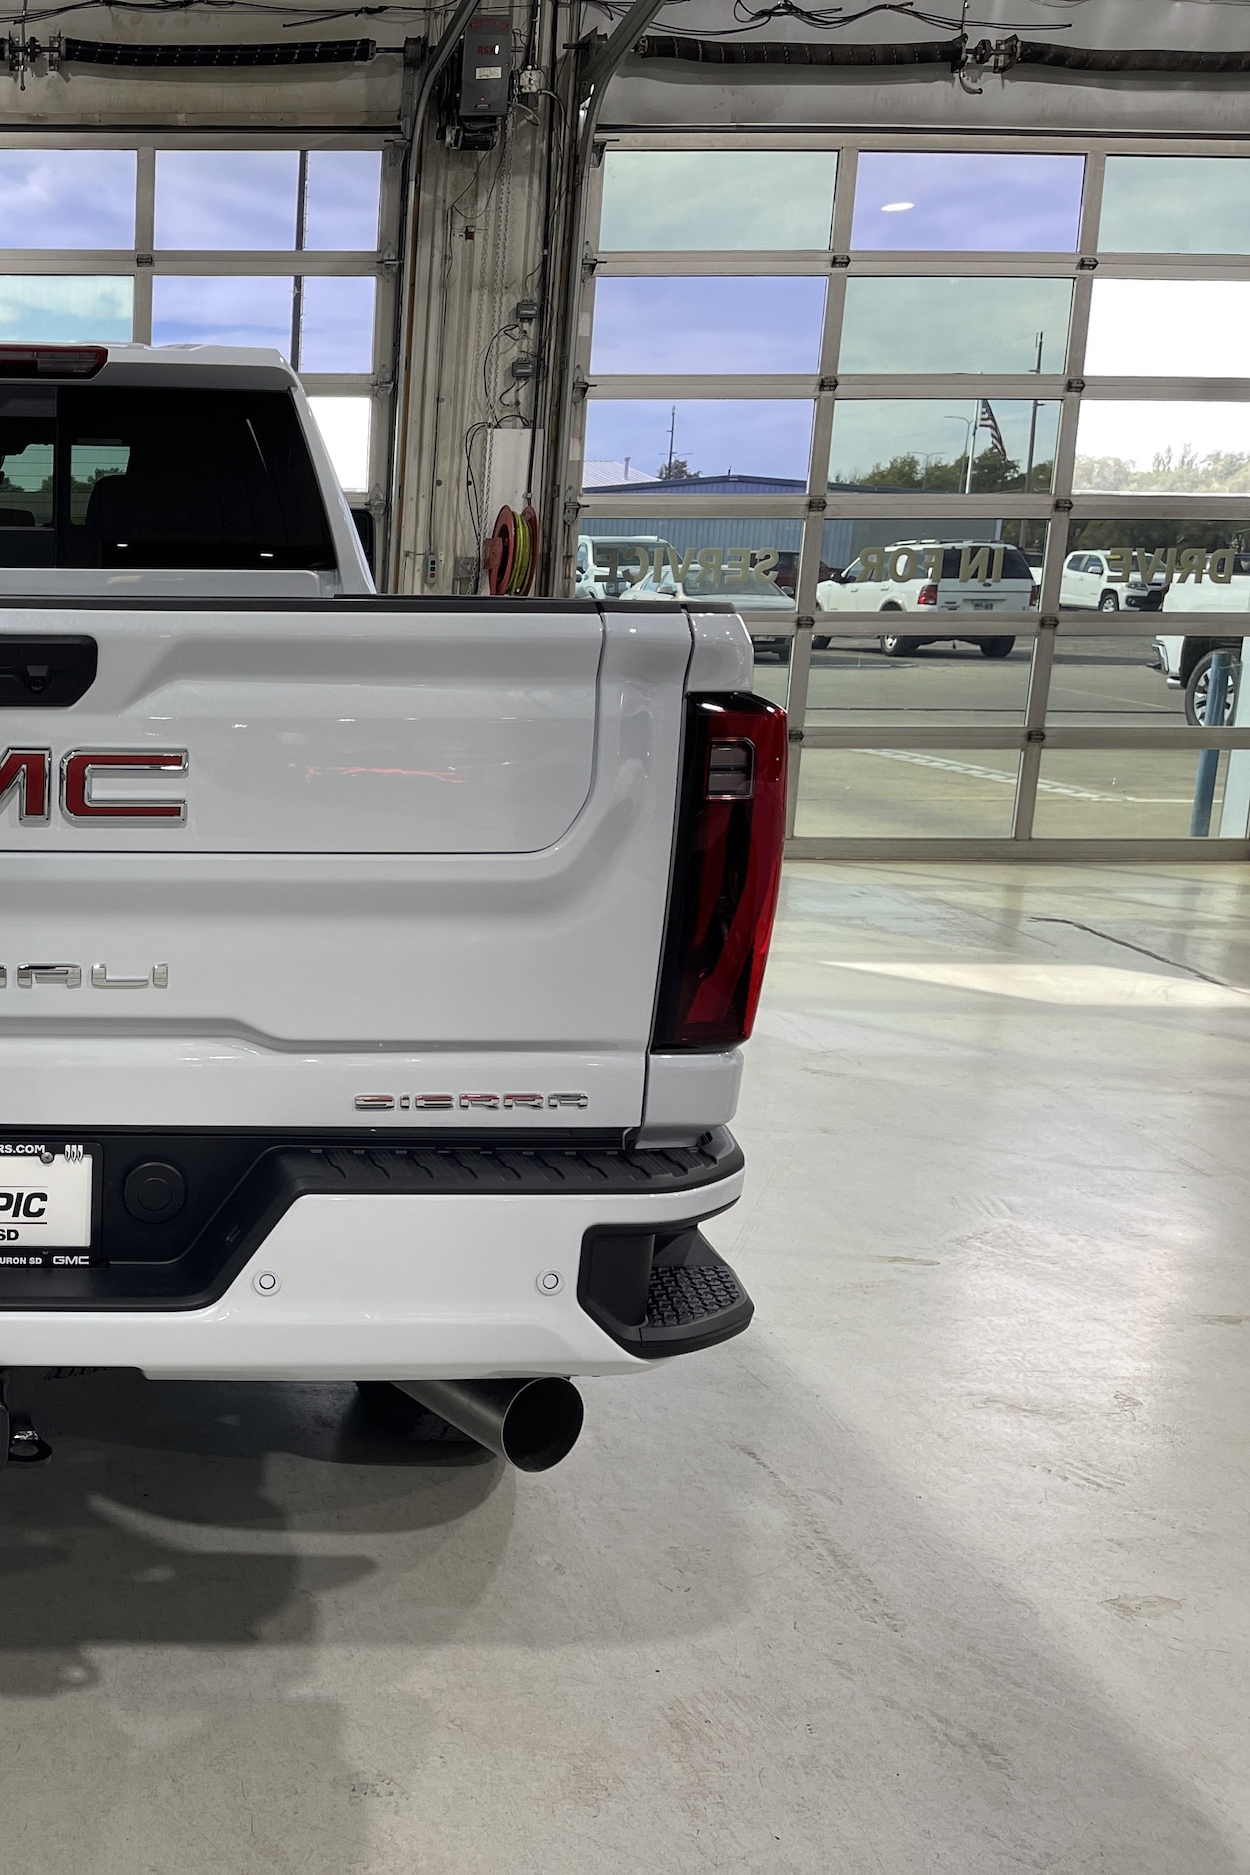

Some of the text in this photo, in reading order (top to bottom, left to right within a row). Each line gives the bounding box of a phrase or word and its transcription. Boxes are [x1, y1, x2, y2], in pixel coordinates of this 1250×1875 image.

[354, 1093, 589, 1109] SIERRA
[29, 1256, 43, 1265] SD
[52, 1256, 90, 1265] GMC
